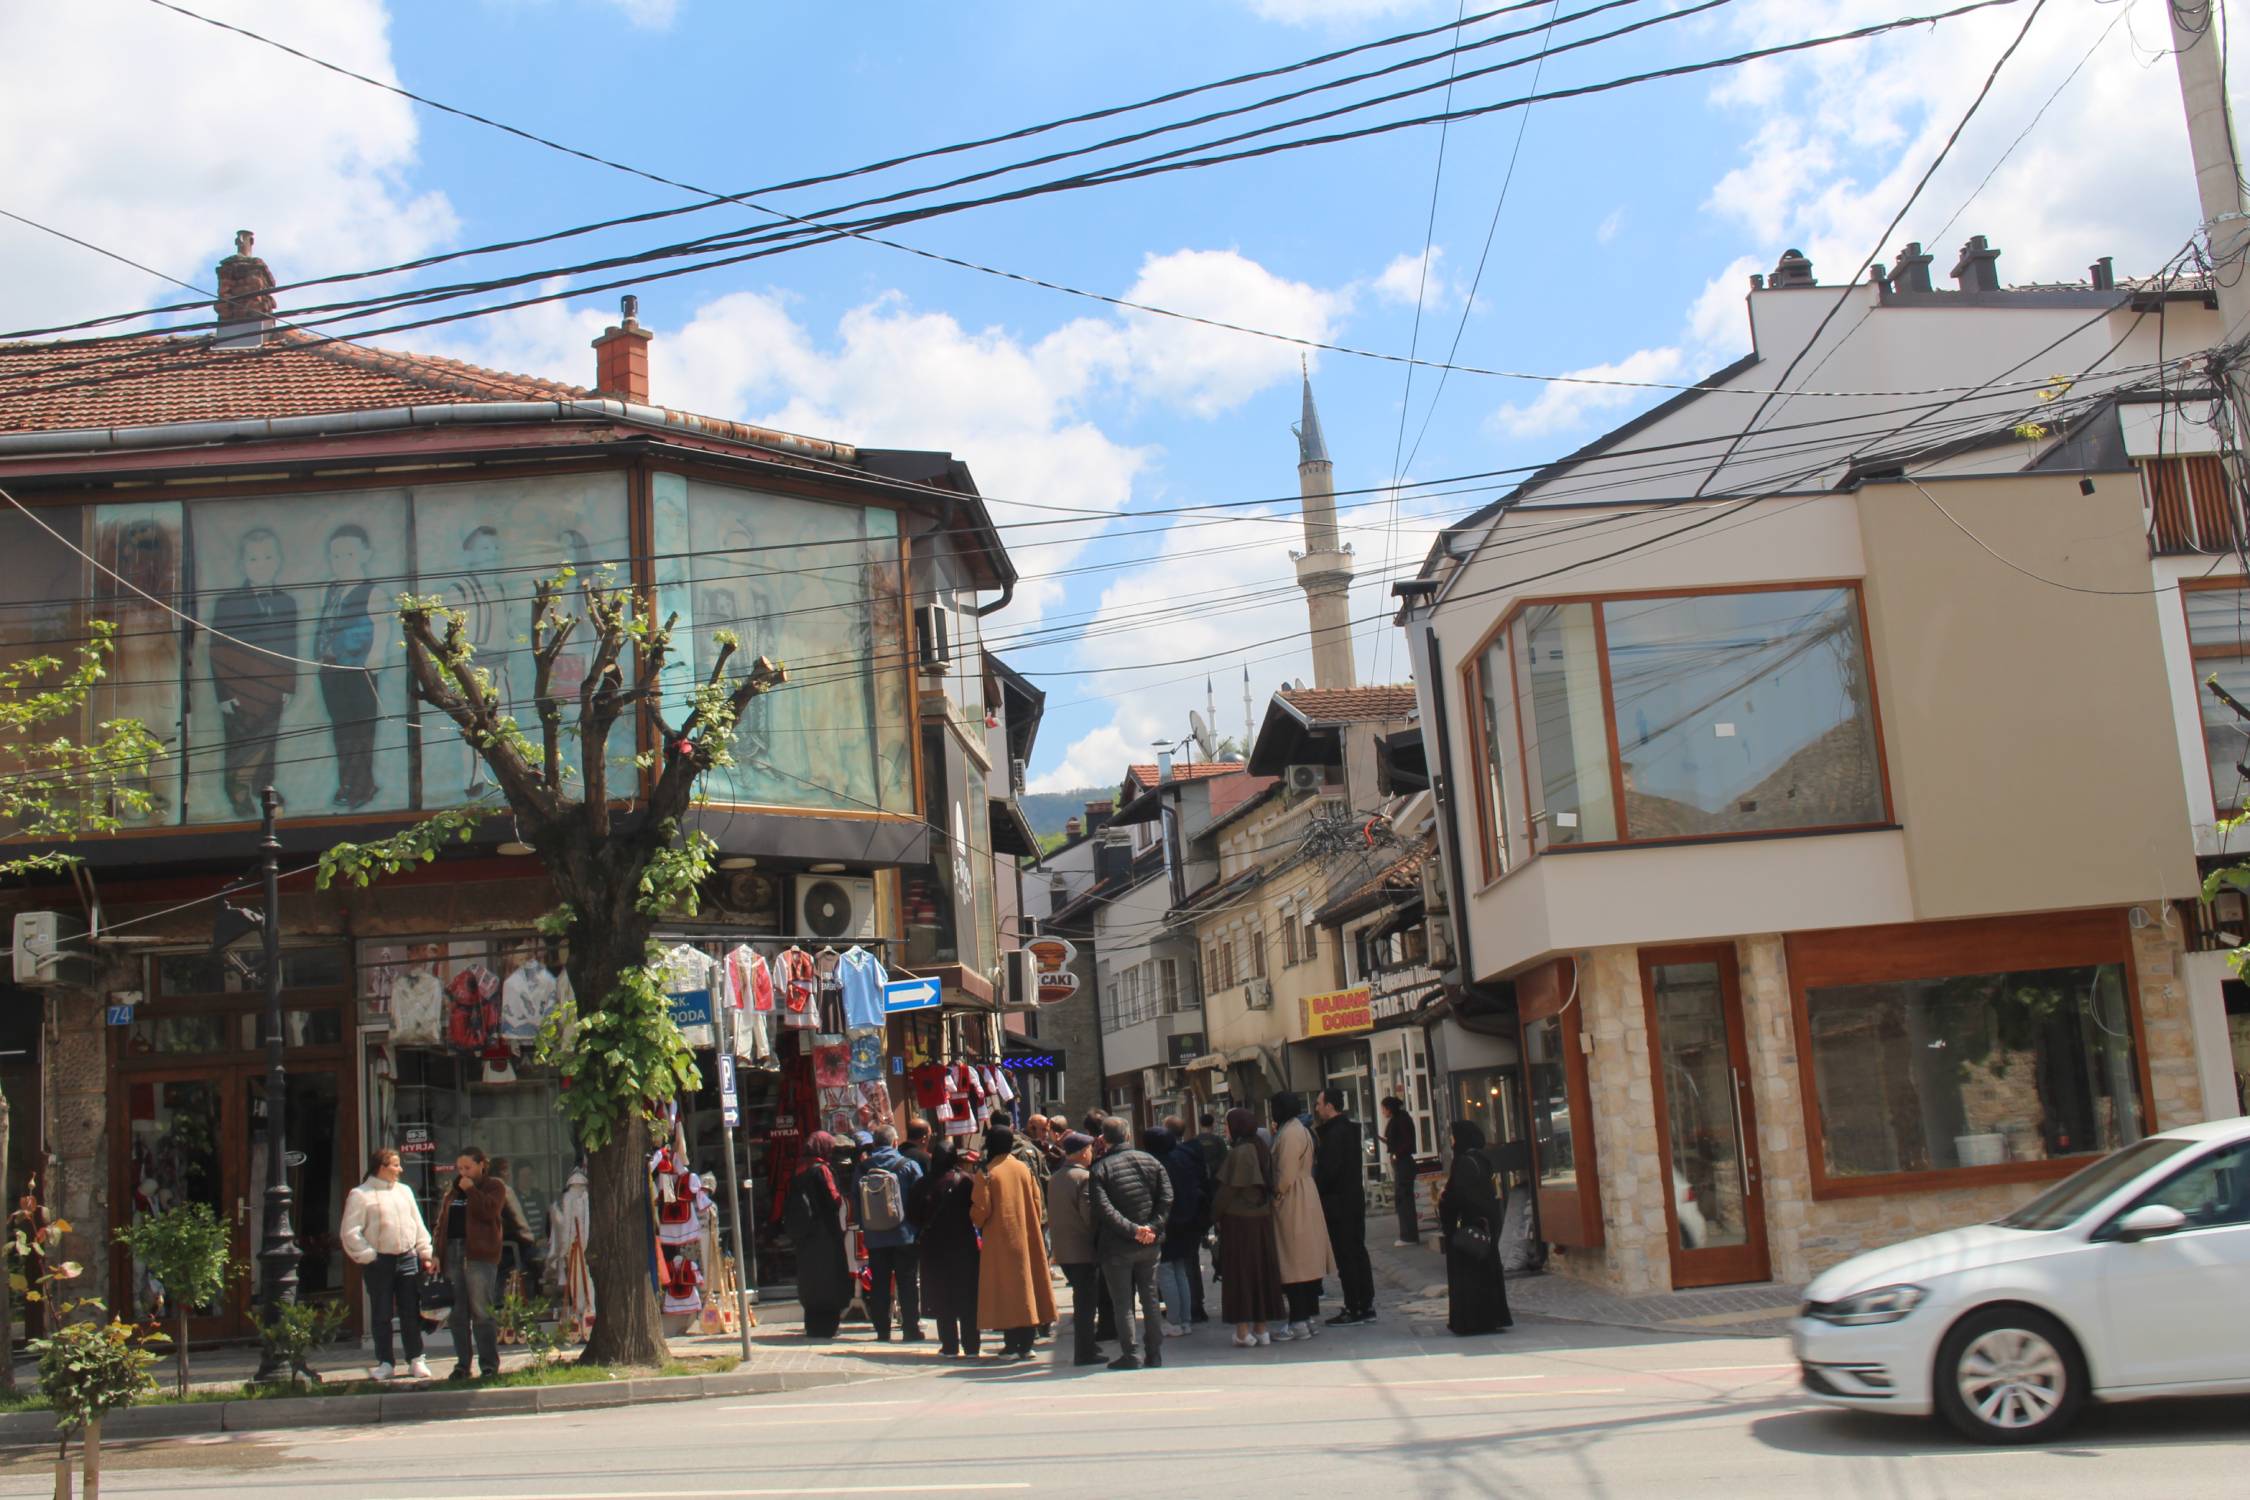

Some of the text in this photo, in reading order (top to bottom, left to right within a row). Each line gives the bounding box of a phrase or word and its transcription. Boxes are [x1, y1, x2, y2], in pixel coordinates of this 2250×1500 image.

[111, 1007, 130, 1024] 74
[1369, 995, 1401, 1019] STAR
[1322, 1008, 1370, 1031] DONER
[770, 1129, 799, 1137] HYRJA
[400, 1142, 436, 1152] HYRJA
